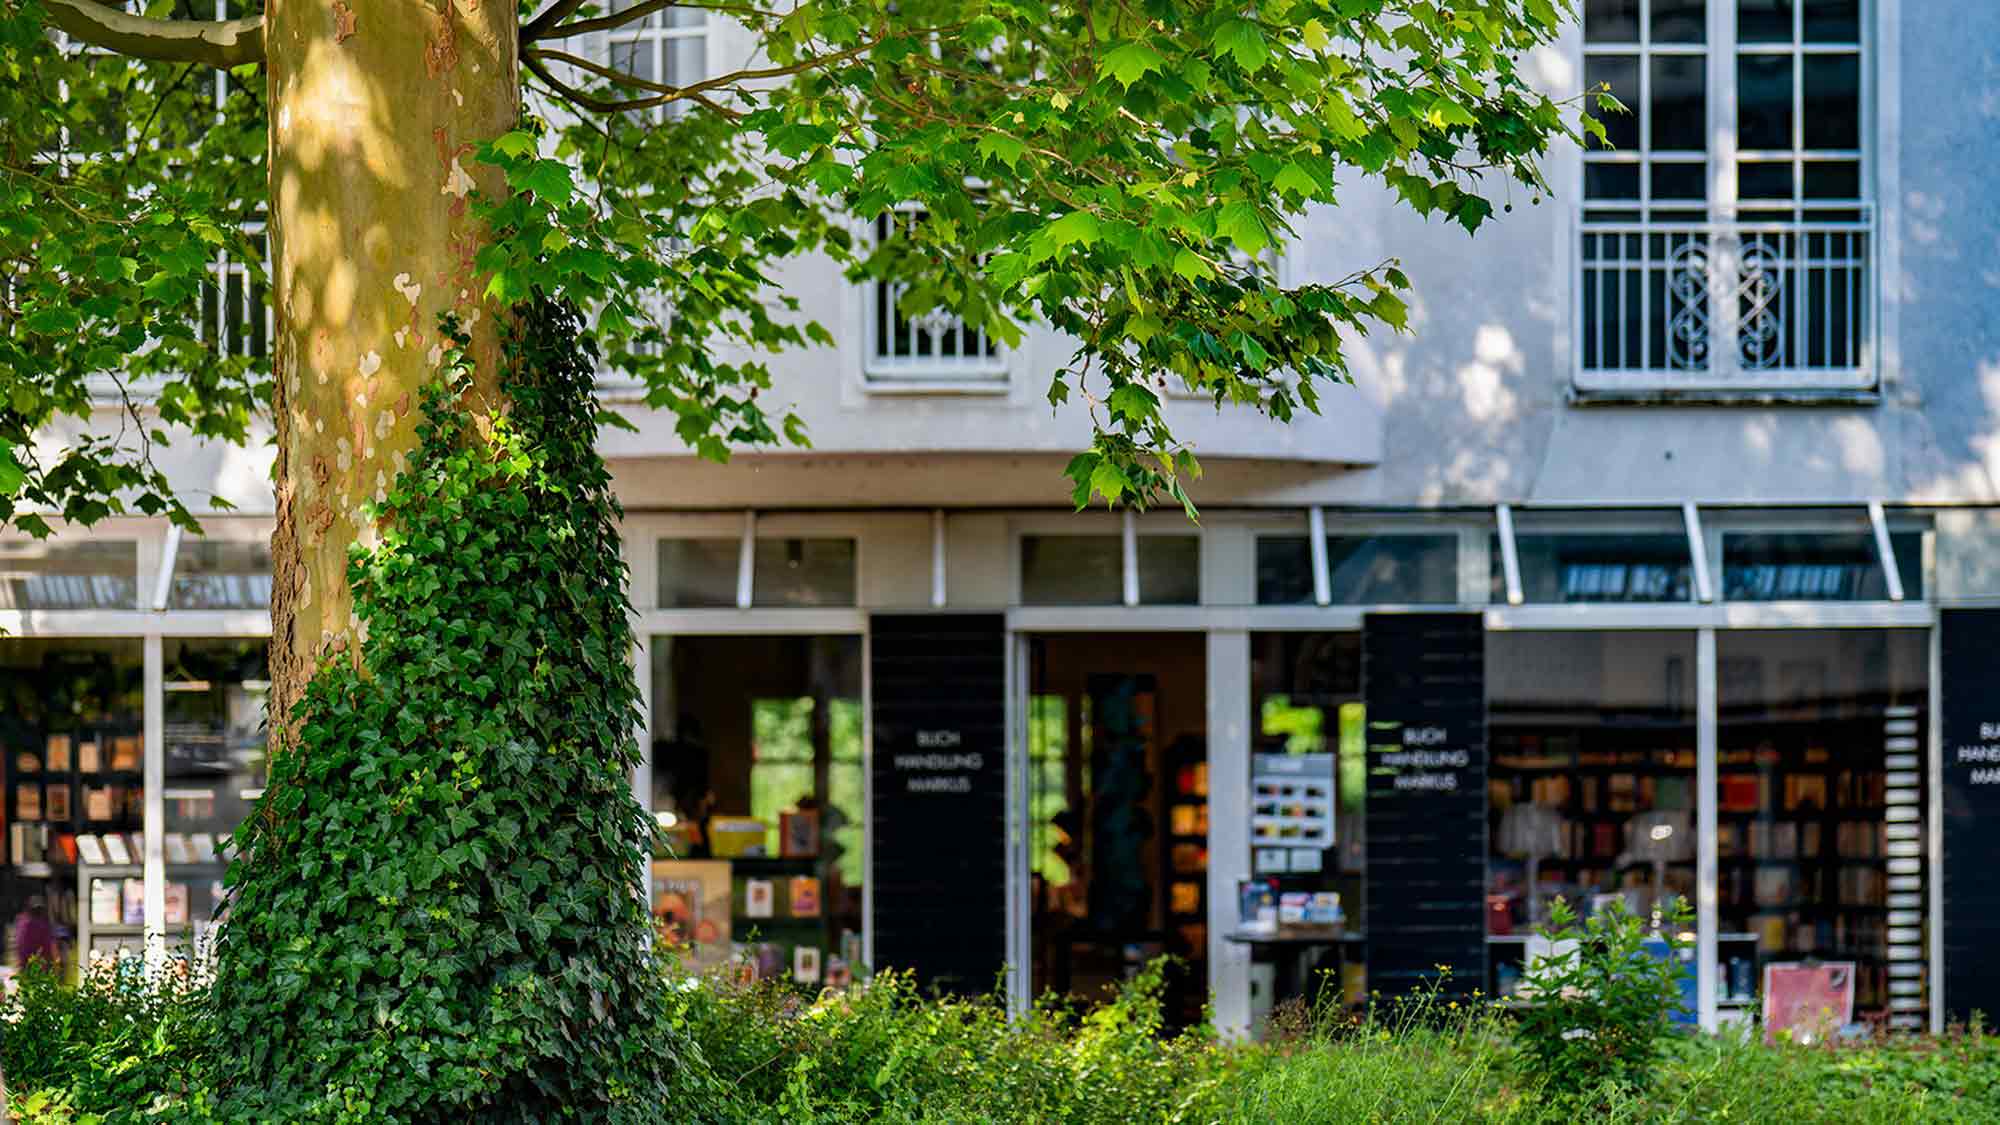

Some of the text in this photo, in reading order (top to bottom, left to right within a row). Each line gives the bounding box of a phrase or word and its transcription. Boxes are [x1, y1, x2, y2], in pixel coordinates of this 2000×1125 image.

[916, 730, 961, 746] BUCH
[1402, 728, 1447, 745] BUCH
[894, 752, 984, 769] HANDLUNG
[1381, 750, 1470, 768] HANDLUNG
